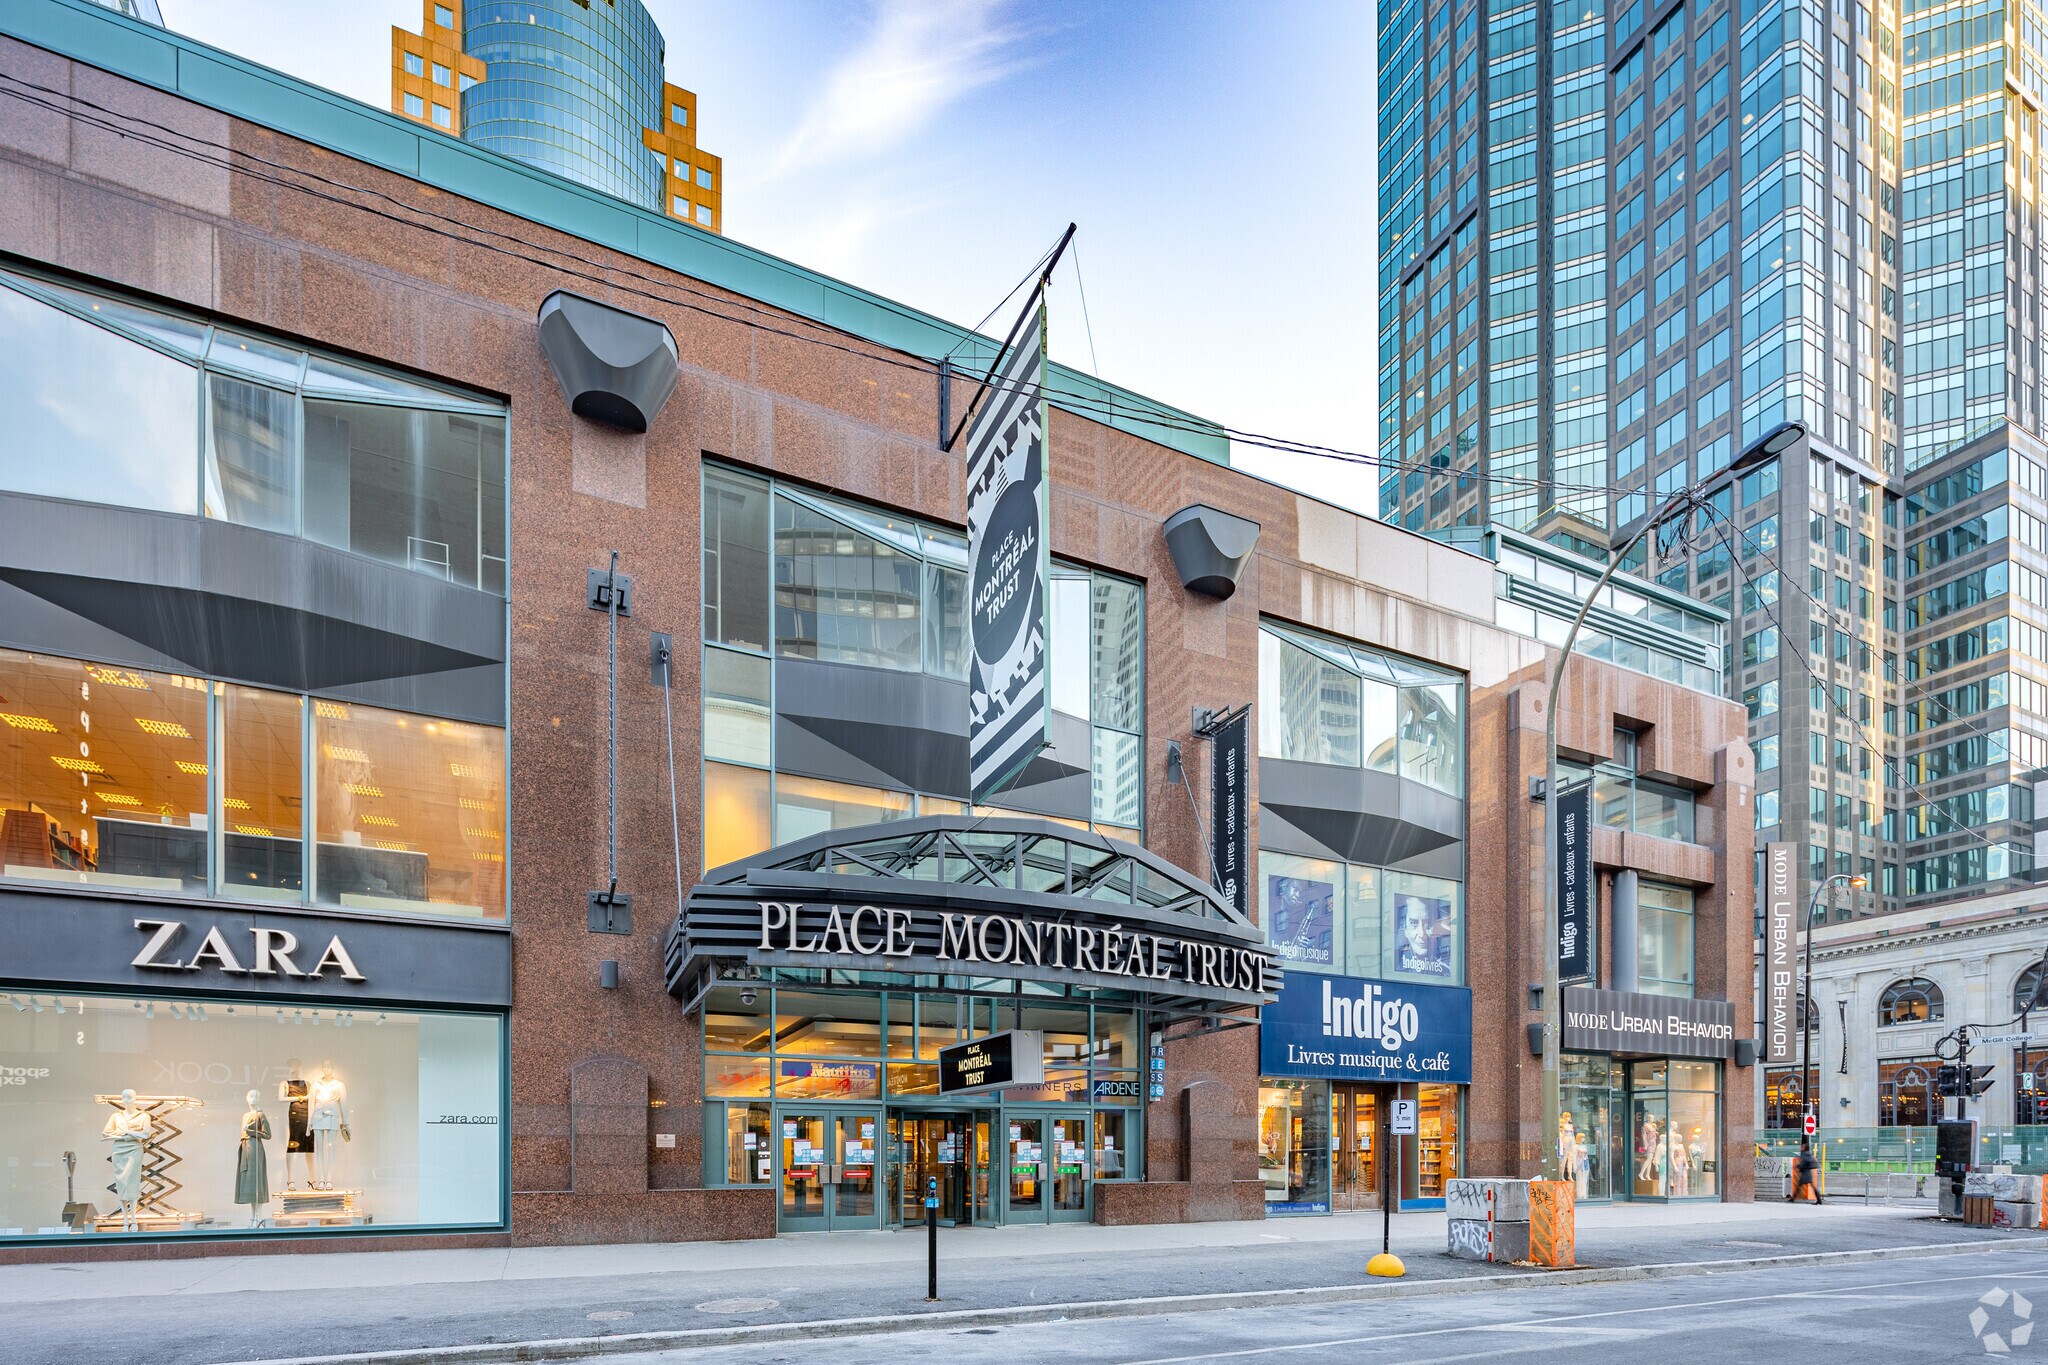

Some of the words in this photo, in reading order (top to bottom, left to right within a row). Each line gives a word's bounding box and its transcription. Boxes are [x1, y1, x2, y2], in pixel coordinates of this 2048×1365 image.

[991, 530, 1014, 568] PLACE
[975, 526, 1035, 616] MONTRÉAL
[987, 569, 1020, 624] TRUST
[1226, 748, 1236, 787] enfants
[1227, 792, 1236, 835] cadeaux
[1564, 812, 1576, 845] enfants
[1225, 841, 1236, 873] Livres
[1564, 850, 1576, 886] cadeaux
[1774, 849, 1787, 895] MODE
[1564, 890, 1576, 917] Livres
[130, 918, 368, 981] ZARA
[757, 902, 914, 956] PLACE
[936, 912, 1172, 981] MONTRÉAL
[1179, 941, 1268, 994] TRUST
[1560, 921, 1578, 960] Indigo
[1773, 901, 1791, 965] URBAN
[1322, 979, 1420, 1051] Indigo
[1567, 1012, 1608, 1031] MODE
[1611, 1010, 1663, 1035] URBAN
[1667, 1015, 1733, 1040] BEHAVIOR
[1773, 971, 1791, 1058] BEHAVIOR
[958, 1052, 992, 1073] MONTRÉAL
[967, 1046, 981, 1055] PLACE
[1287, 1044, 1335, 1066] Livres
[1339, 1051, 1403, 1076] musique
[1405, 1052, 1421, 1072] &
[1421, 1051, 1450, 1072] café
[811, 1062, 871, 1079] Nautilus
[965, 1070, 985, 1086] TRUST
[1094, 1082, 1140, 1096] ARDENE
[439, 1114, 498, 1125] zara.com
[1399, 1103, 1408, 1115] P
